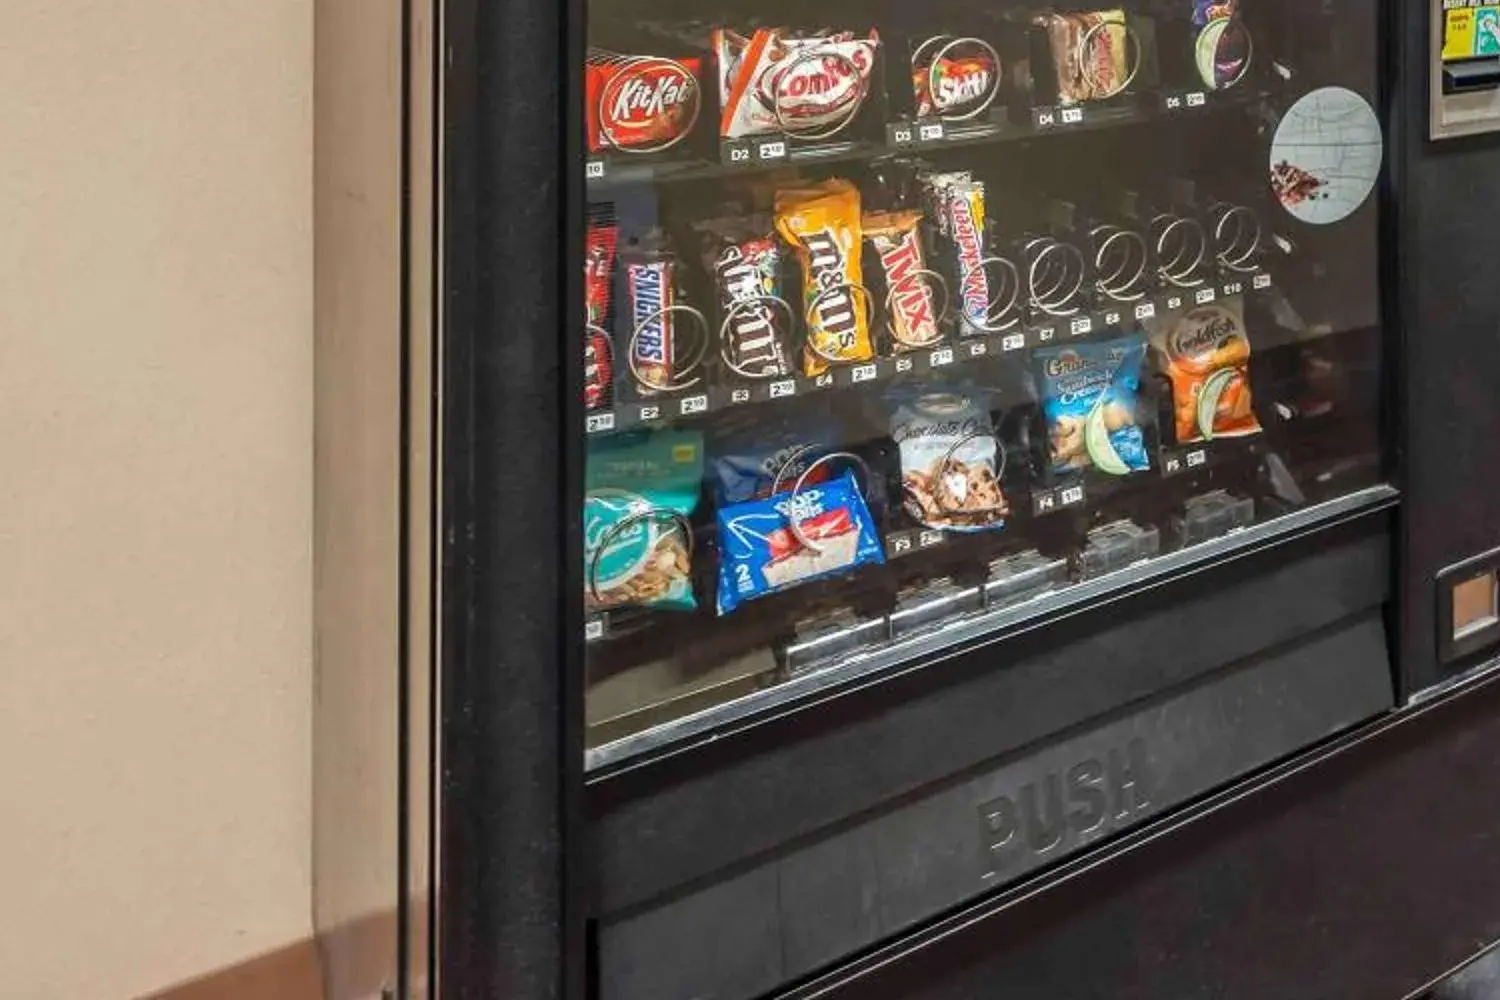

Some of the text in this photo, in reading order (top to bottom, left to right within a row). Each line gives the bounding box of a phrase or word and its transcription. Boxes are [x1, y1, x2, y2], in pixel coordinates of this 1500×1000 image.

[732, 149, 749, 161] D2
[641, 406, 660, 419] E2
[976, 737, 1149, 879] PUSH
